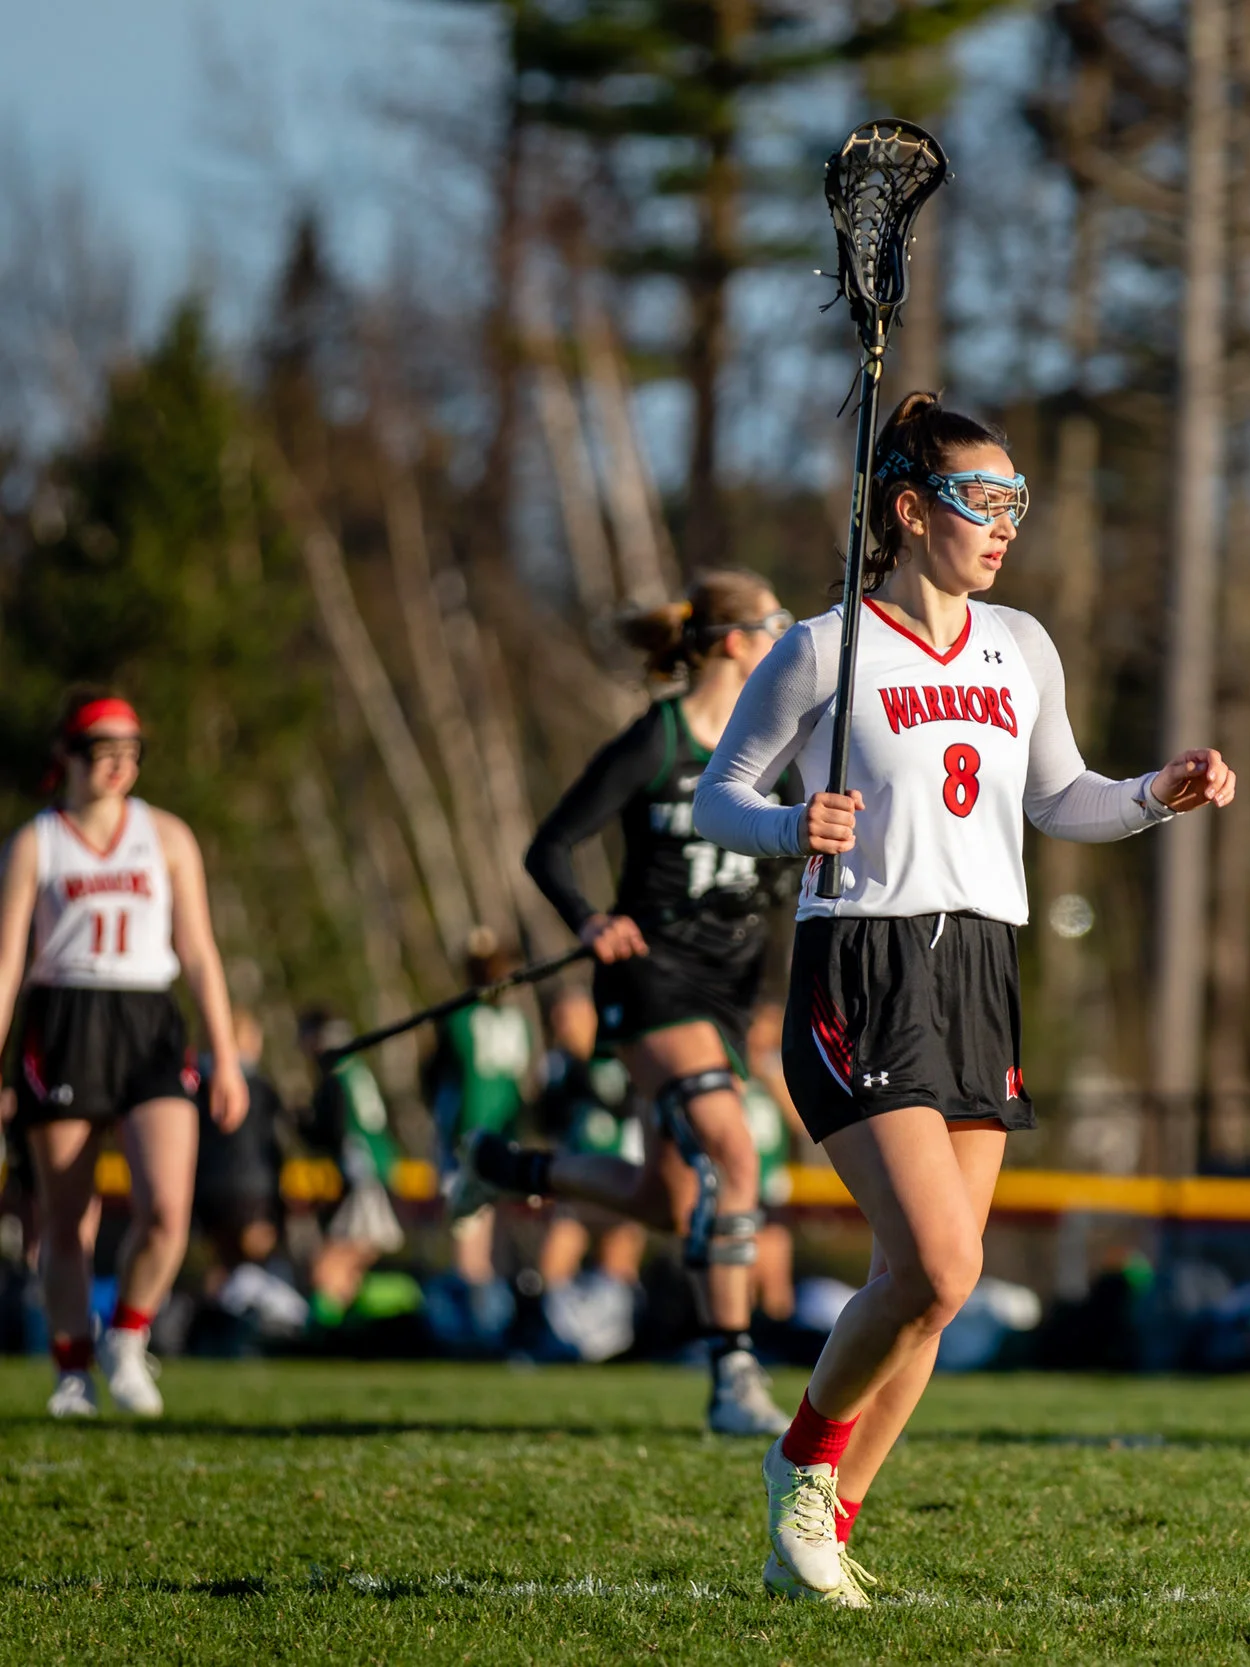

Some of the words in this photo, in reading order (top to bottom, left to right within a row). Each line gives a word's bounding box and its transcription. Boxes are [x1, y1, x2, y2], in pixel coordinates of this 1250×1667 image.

[877, 685, 1018, 738] WARRIORS
[943, 743, 981, 818] 8
[90, 910, 129, 956] 11
